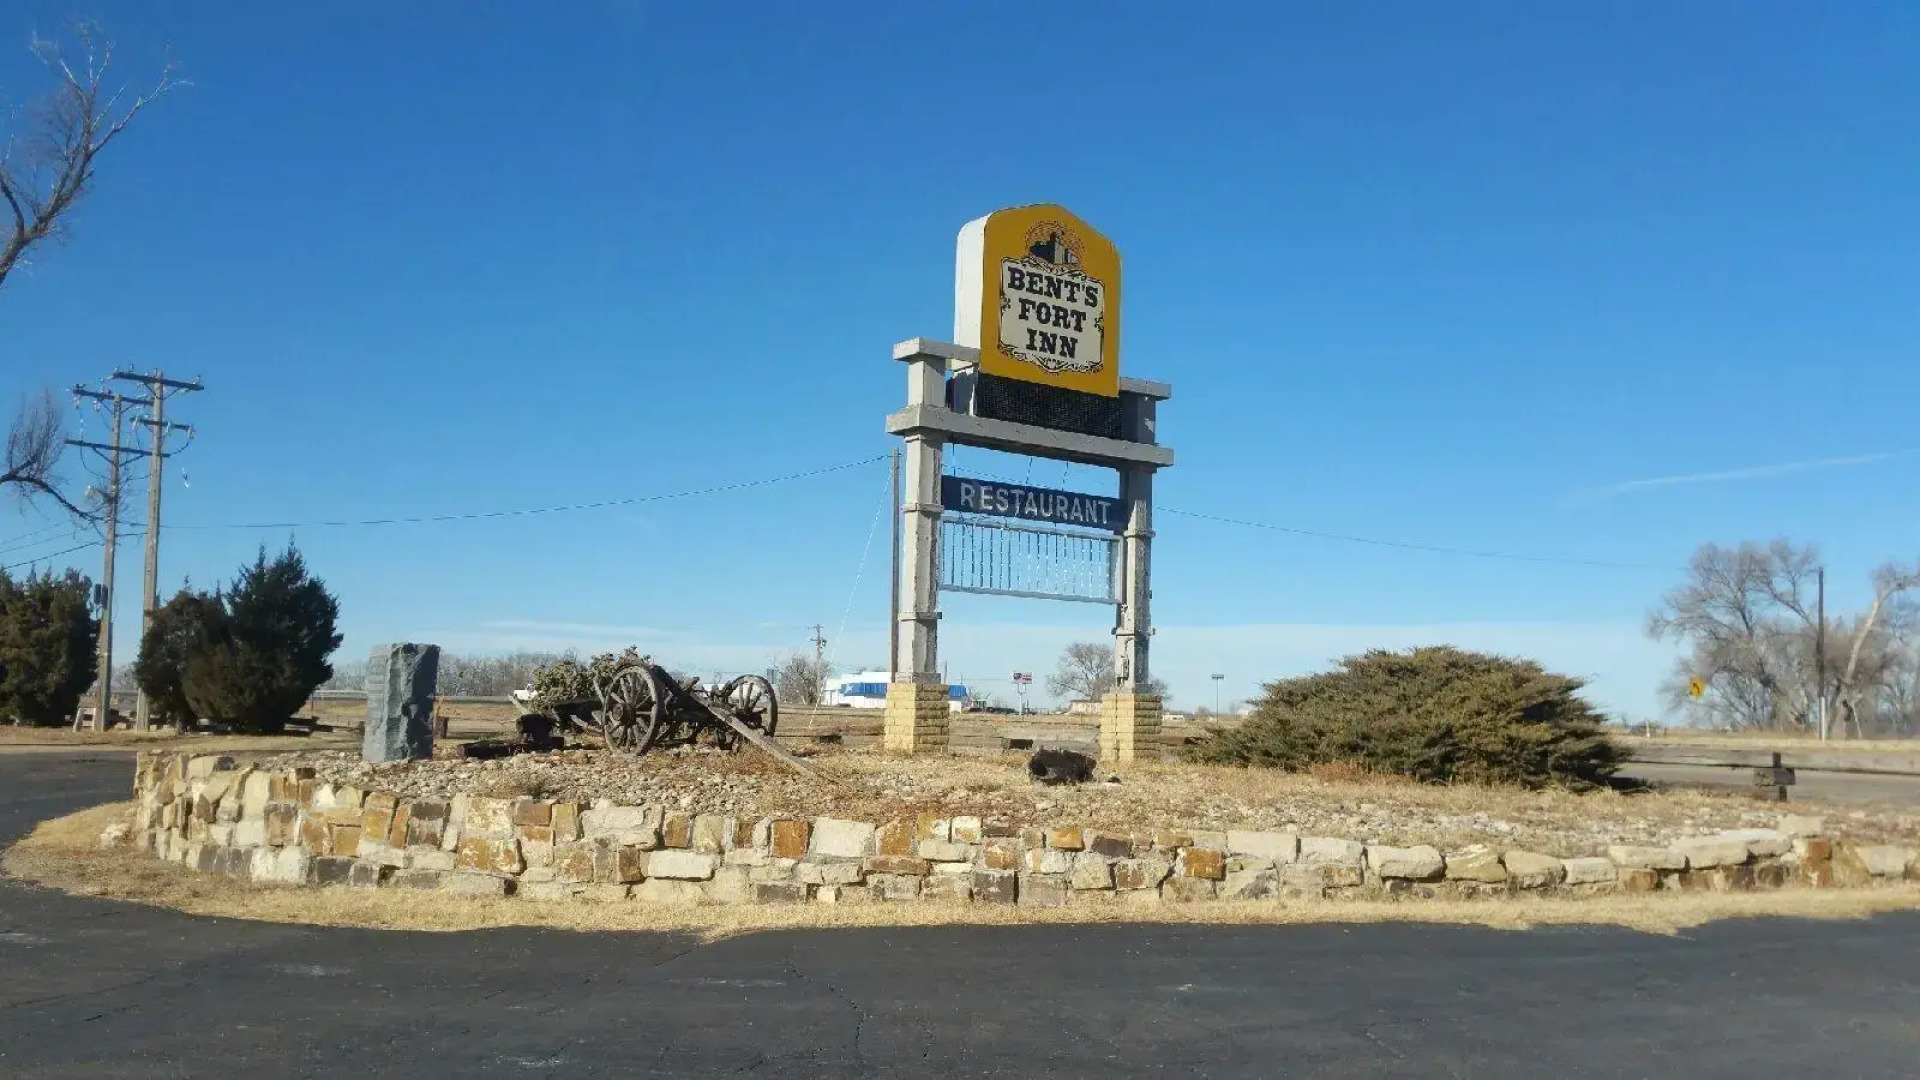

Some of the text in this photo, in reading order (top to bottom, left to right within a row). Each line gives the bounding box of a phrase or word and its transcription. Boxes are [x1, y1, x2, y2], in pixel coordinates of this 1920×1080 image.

[1008, 266, 1098, 308] BENT'S
[1019, 298, 1086, 332] FORT
[1026, 328, 1078, 358] INN
[960, 483, 1112, 524] RESTAURANT
